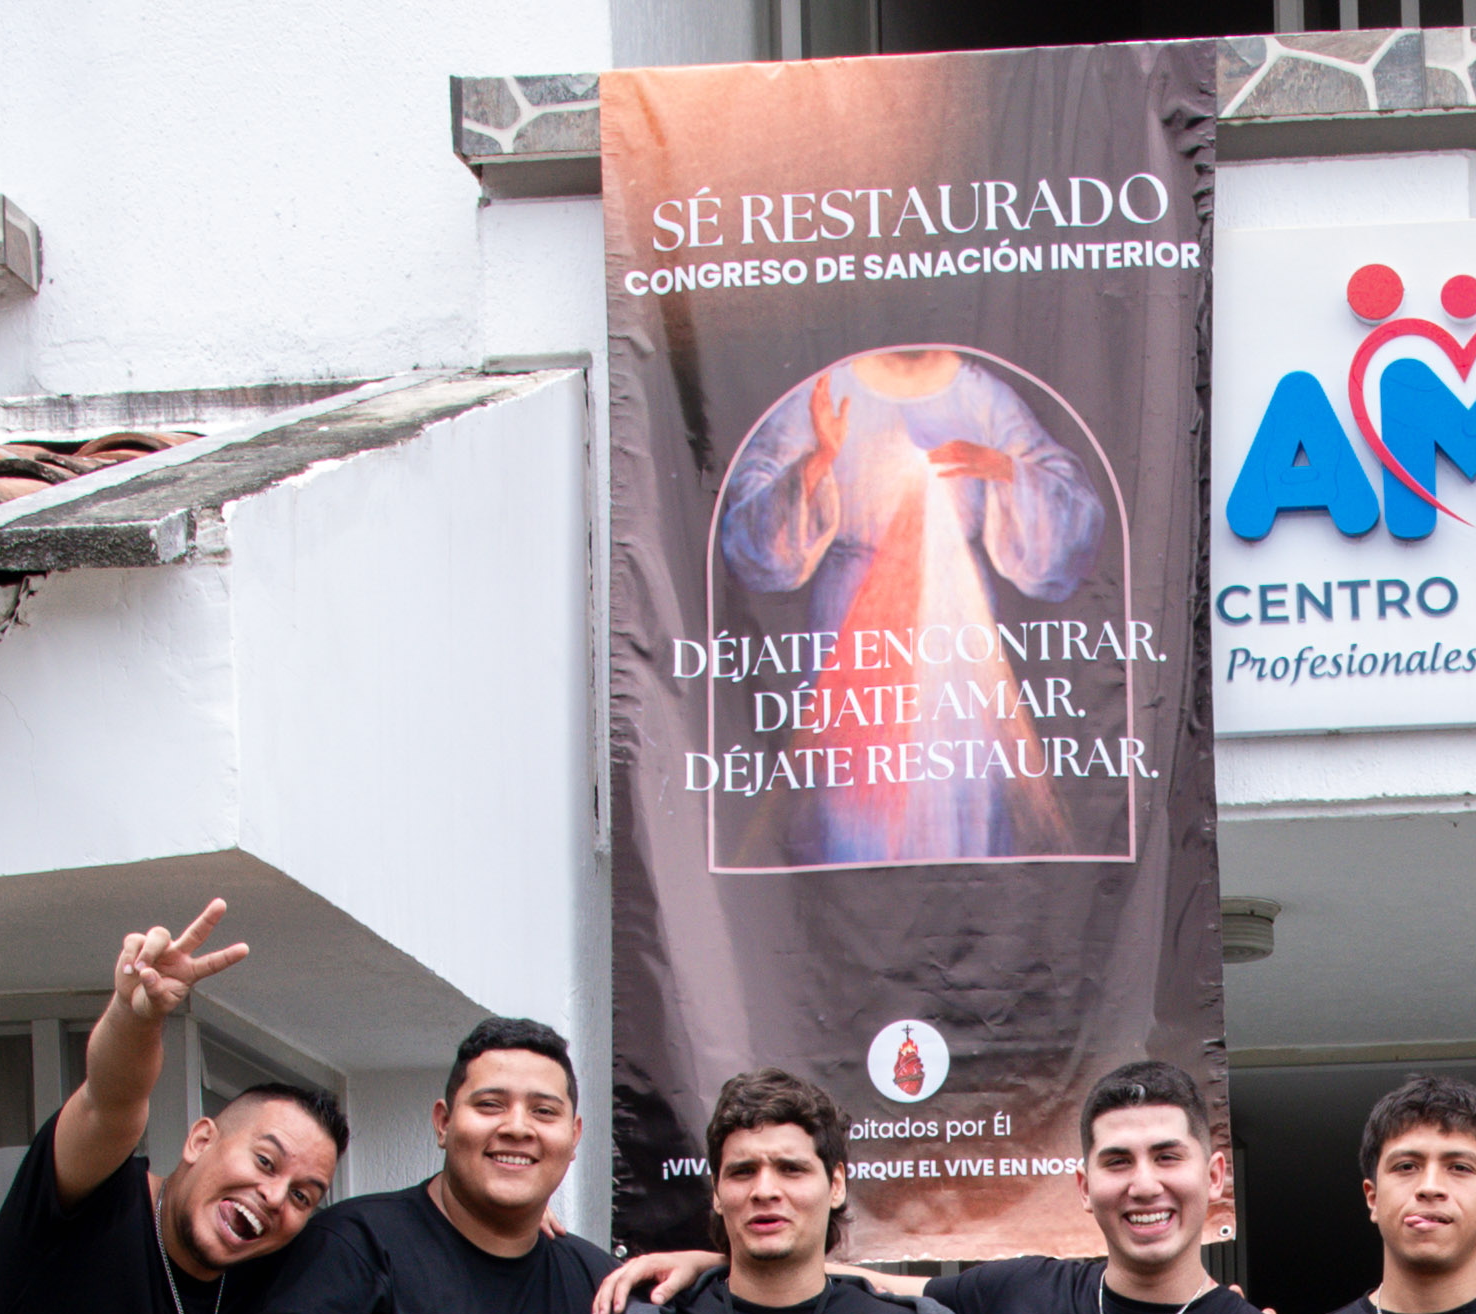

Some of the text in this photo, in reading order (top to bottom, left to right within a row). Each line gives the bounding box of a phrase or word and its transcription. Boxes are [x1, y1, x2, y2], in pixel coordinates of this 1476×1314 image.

[652, 172, 1170, 252] SÉ RESTAURADO
[623, 238, 1202, 297] CONGRESO DE SANACIÓN INTERIOR
[1214, 575, 1460, 627] CENTRO
[671, 619, 1168, 684] DÉJATE ENCONTRAR.
[753, 676, 1087, 734] DÉJATE AMAR.
[683, 736, 1161, 798] DÉJATE RESTAURAR.
[849, 1110, 1012, 1144] bitados por Él
[847, 1159, 915, 1181] ORQUE
[918, 1159, 942, 1179] EL
[944, 1158, 995, 1177] VIVE
[998, 1158, 1028, 1177] EN
